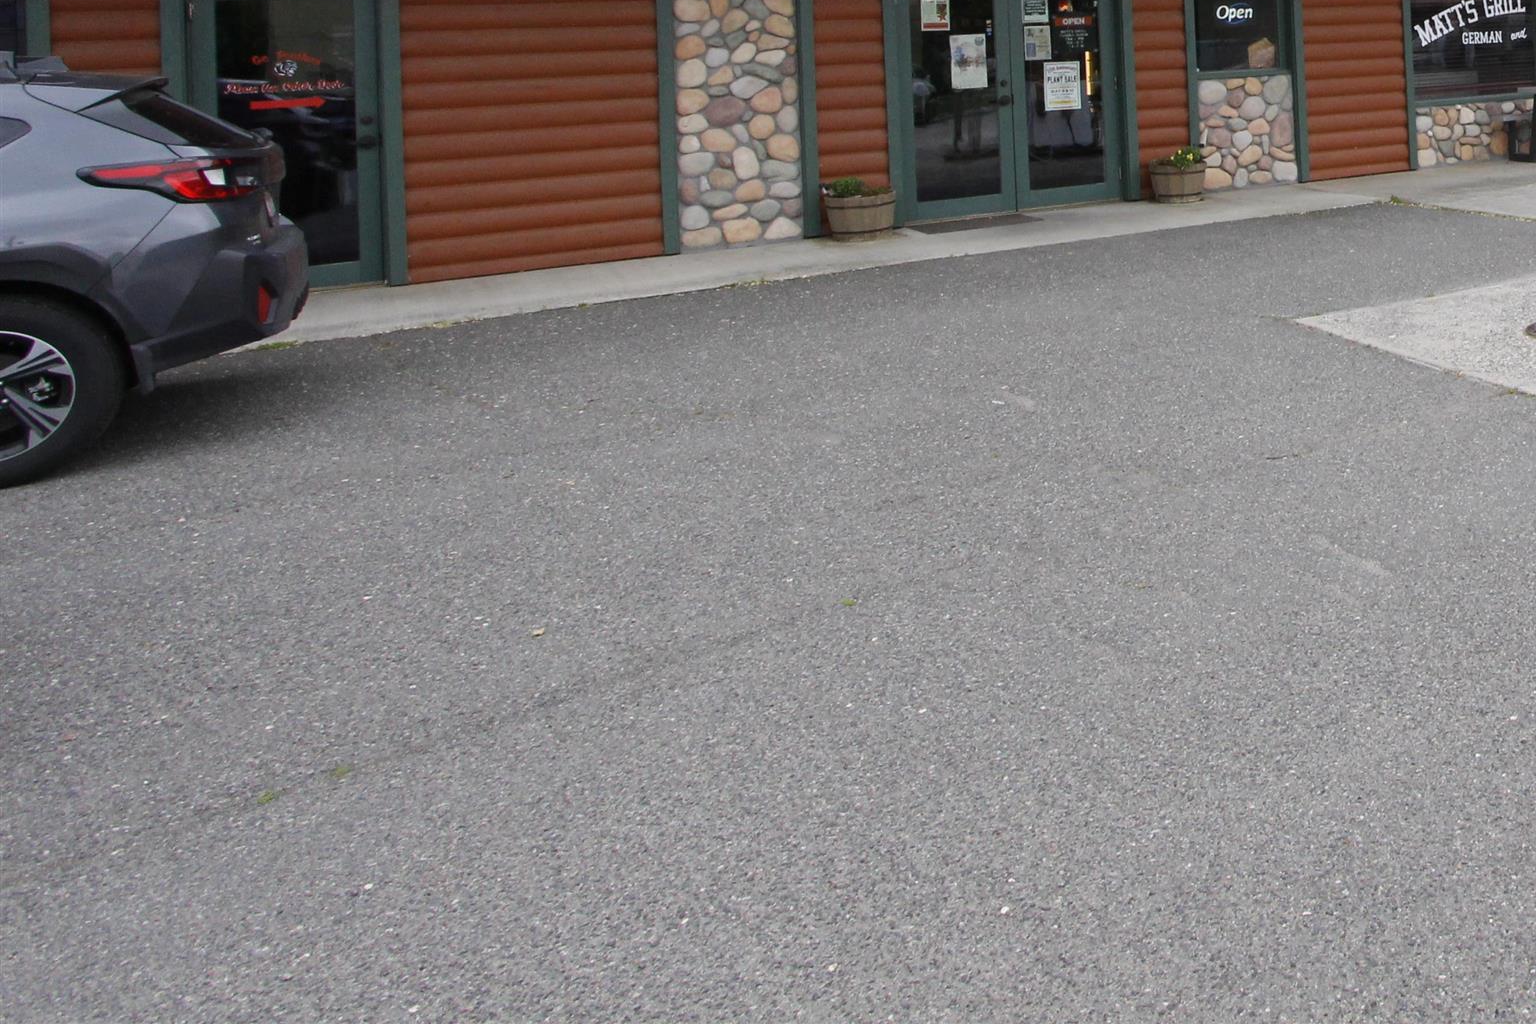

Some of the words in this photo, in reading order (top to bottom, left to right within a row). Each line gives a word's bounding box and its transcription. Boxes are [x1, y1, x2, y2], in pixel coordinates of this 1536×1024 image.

[1062, 17, 1085, 25] OPEN
[1216, 5, 1253, 22] Open
[1414, 0, 1479, 47] MATT'S
[1462, 31, 1503, 45] GERMAN
[1511, 28, 1527, 40] and
